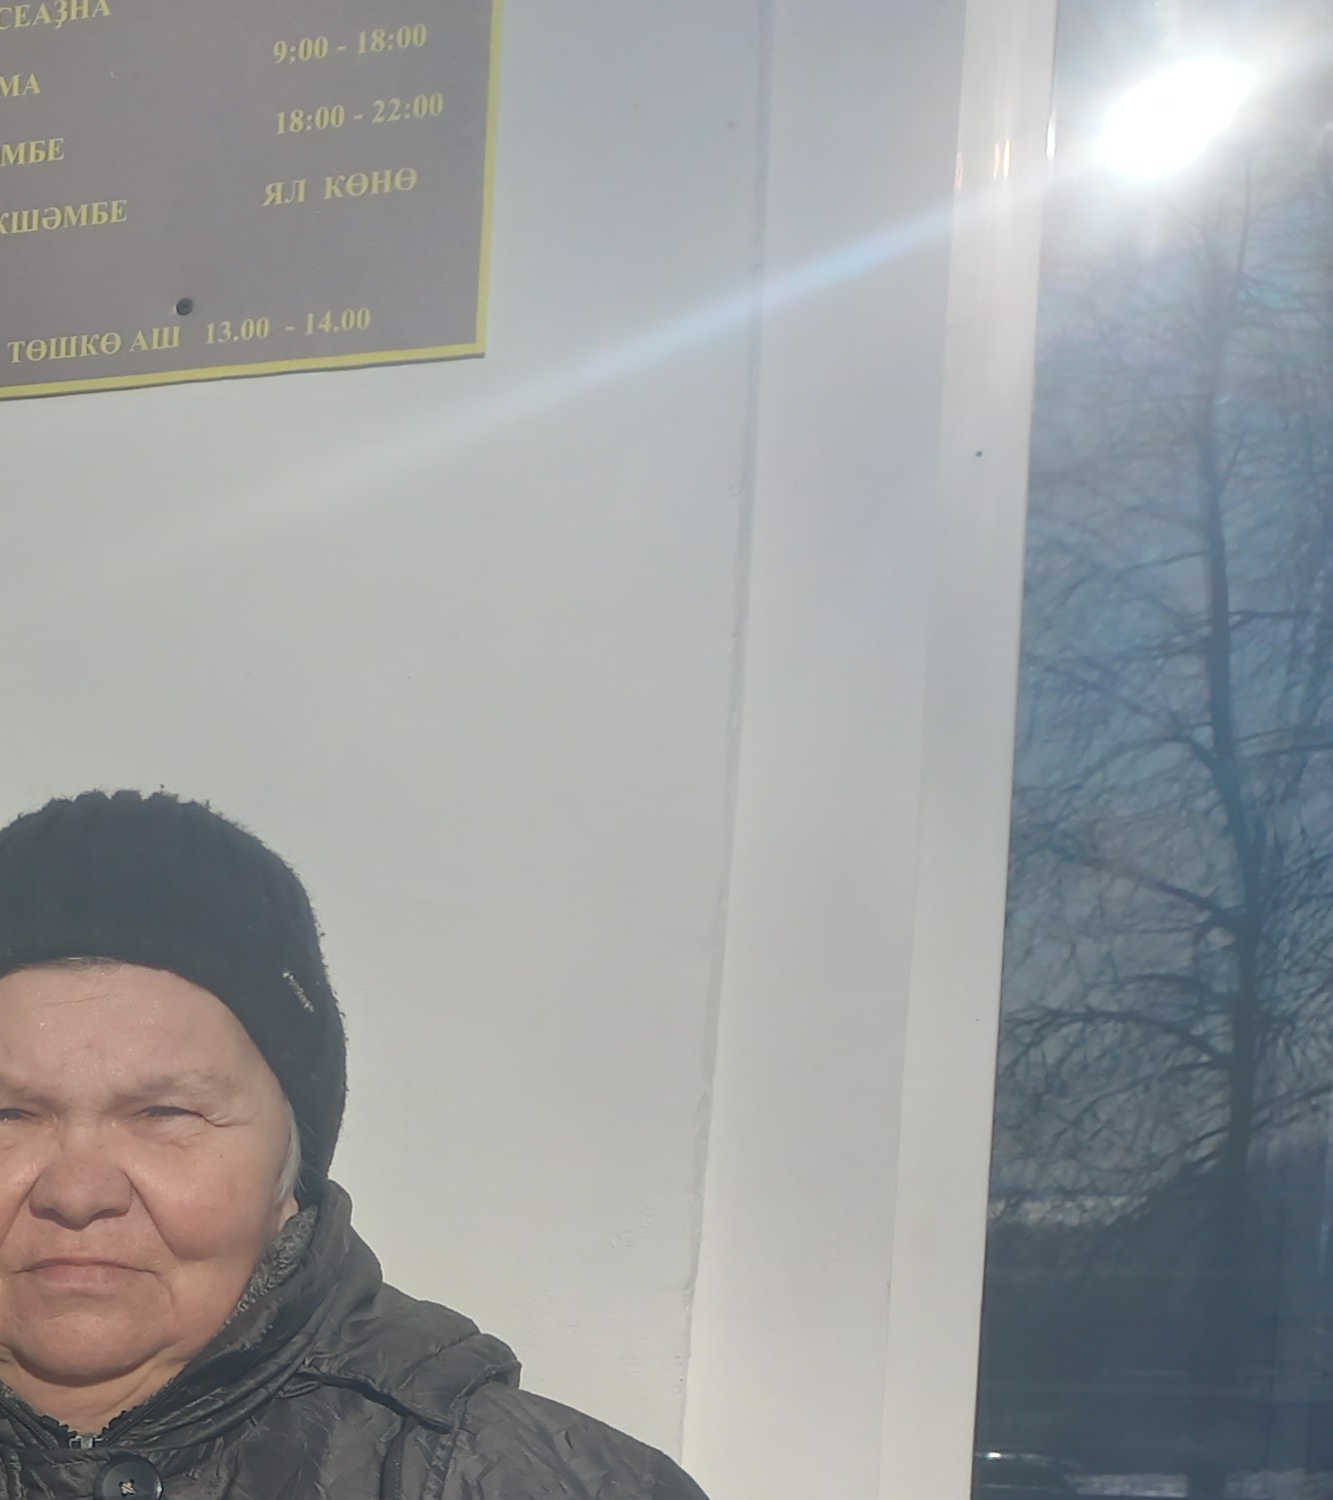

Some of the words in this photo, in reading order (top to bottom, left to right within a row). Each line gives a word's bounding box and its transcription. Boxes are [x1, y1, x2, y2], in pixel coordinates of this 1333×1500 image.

[273, 34, 328, 64] 9:00
[357, 24, 428, 54] 18:00
[275, 104, 345, 134] 18:00
[371, 92, 443, 124] 22:00
[263, 179, 307, 206] ЯЛ
[129, 326, 179, 354] АШ
[205, 316, 269, 345] 13.00
[305, 308, 371, 335] 14.00
